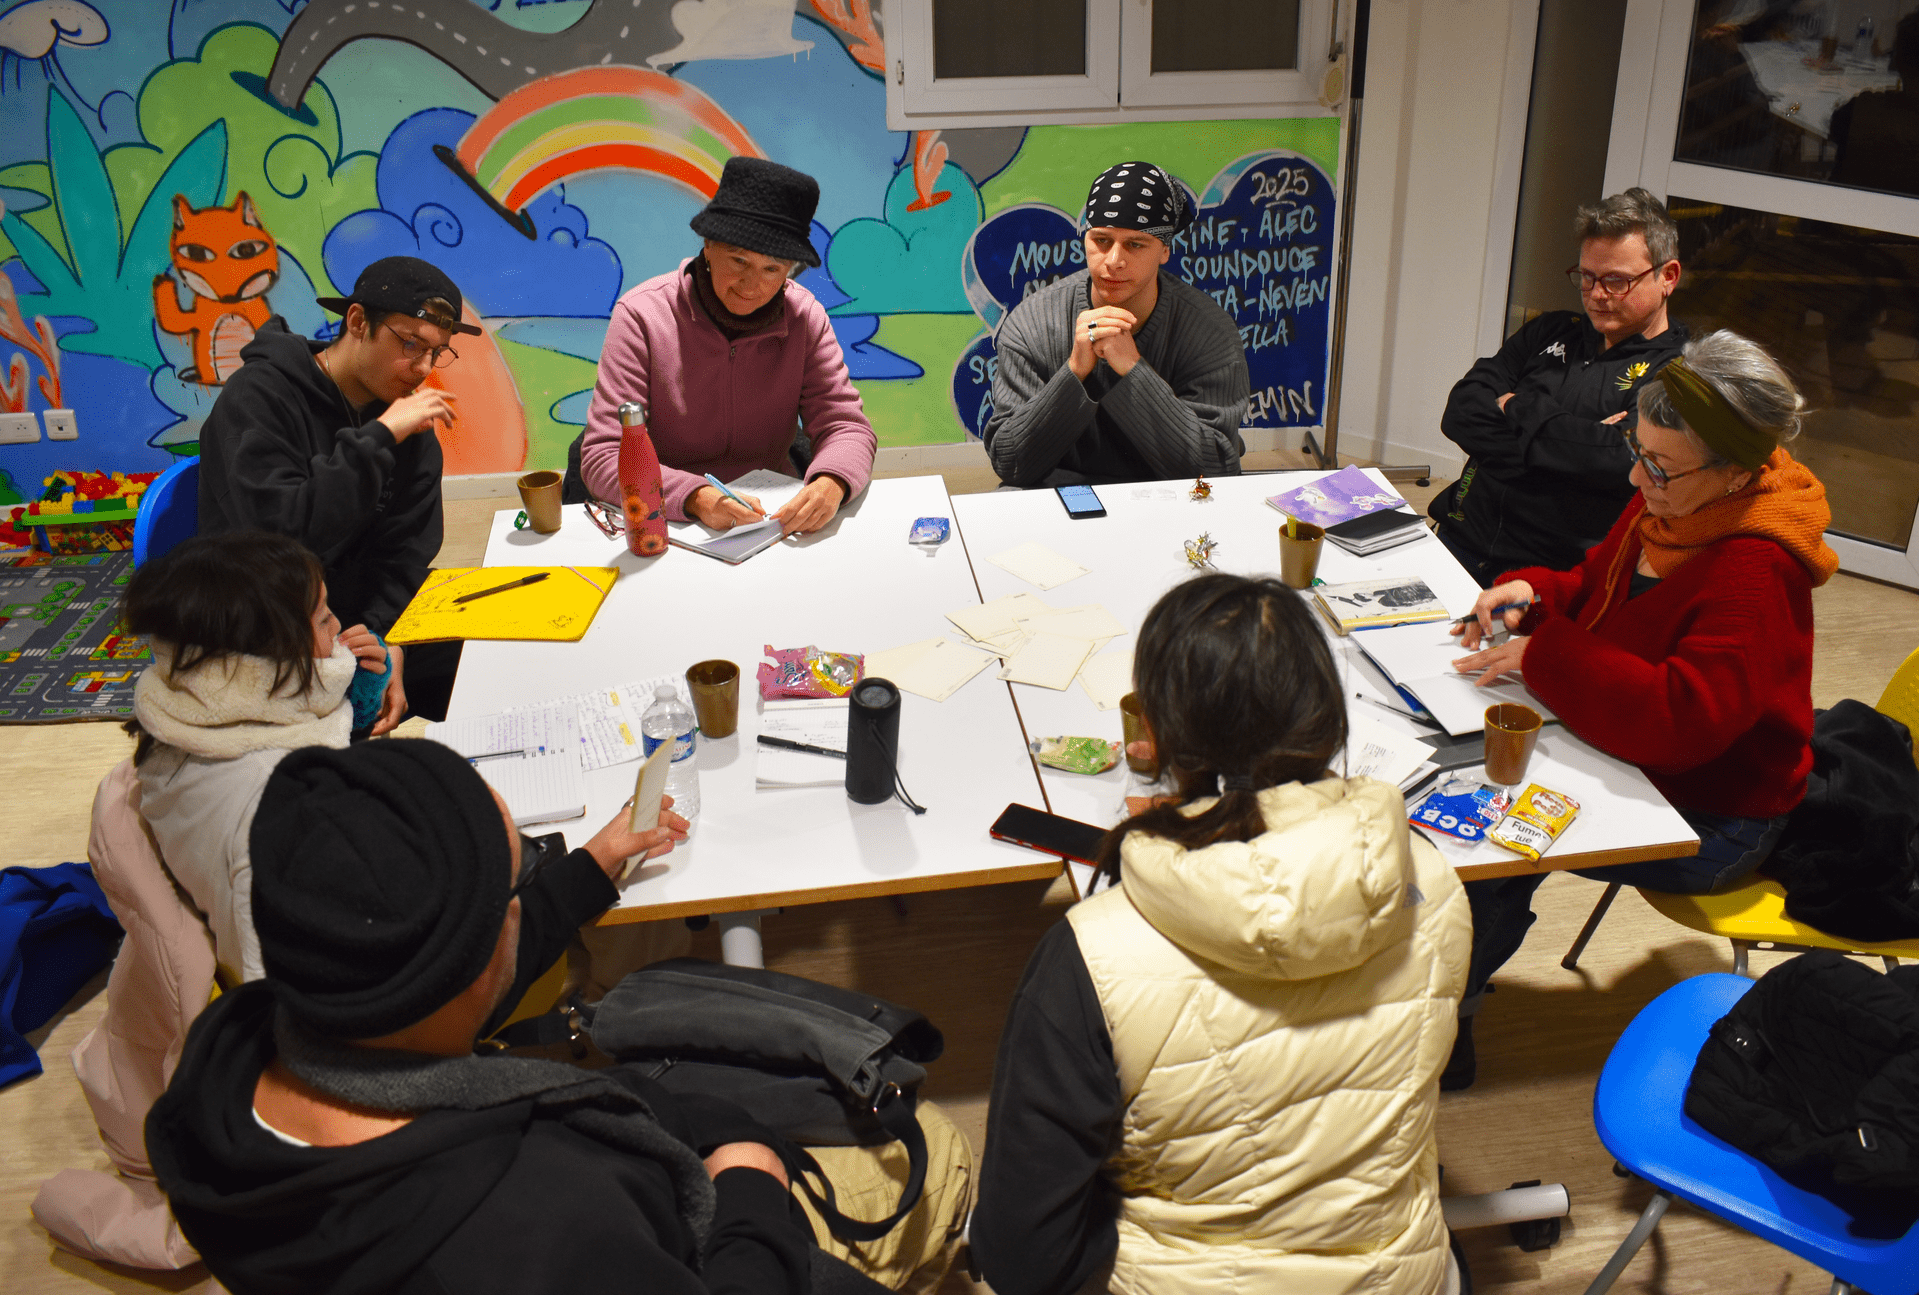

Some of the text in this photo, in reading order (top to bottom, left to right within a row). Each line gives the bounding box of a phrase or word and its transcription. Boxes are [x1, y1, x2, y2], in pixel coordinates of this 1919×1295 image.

[1250, 167, 1309, 204] 2025
[1259, 205, 1317, 245] ALEC
[1180, 246, 1319, 291] SOUNDOUCE
[1421, 809, 1476, 837] OCB
[1515, 834, 1533, 843] tue
